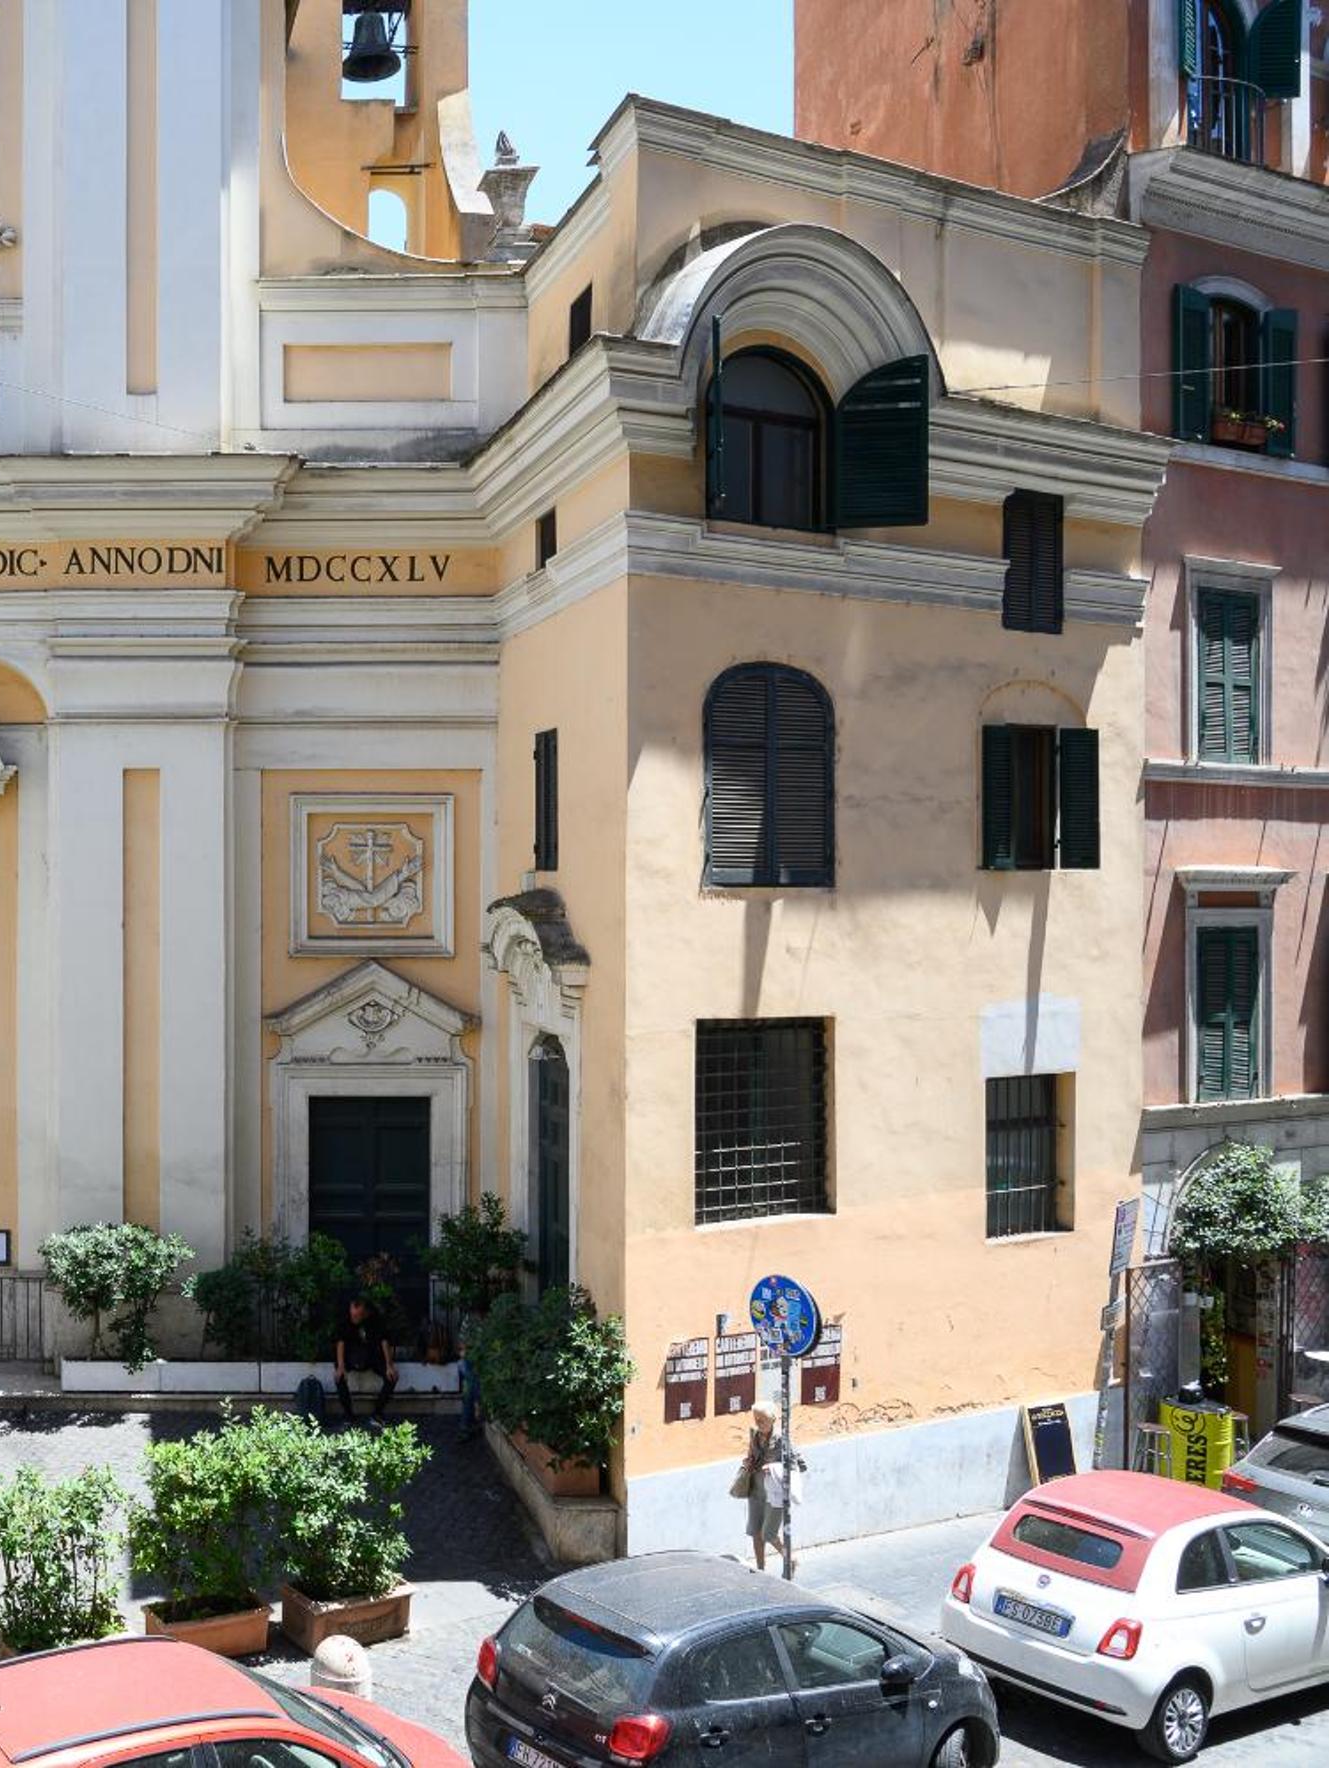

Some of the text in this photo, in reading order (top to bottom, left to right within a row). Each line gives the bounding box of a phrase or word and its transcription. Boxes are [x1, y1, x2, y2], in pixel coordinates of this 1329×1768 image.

[62, 546, 163, 576] ANNO
[165, 546, 225, 575] DNI
[265, 554, 451, 584] MDCCXLV
[1185, 1434, 1208, 1485] ERES
